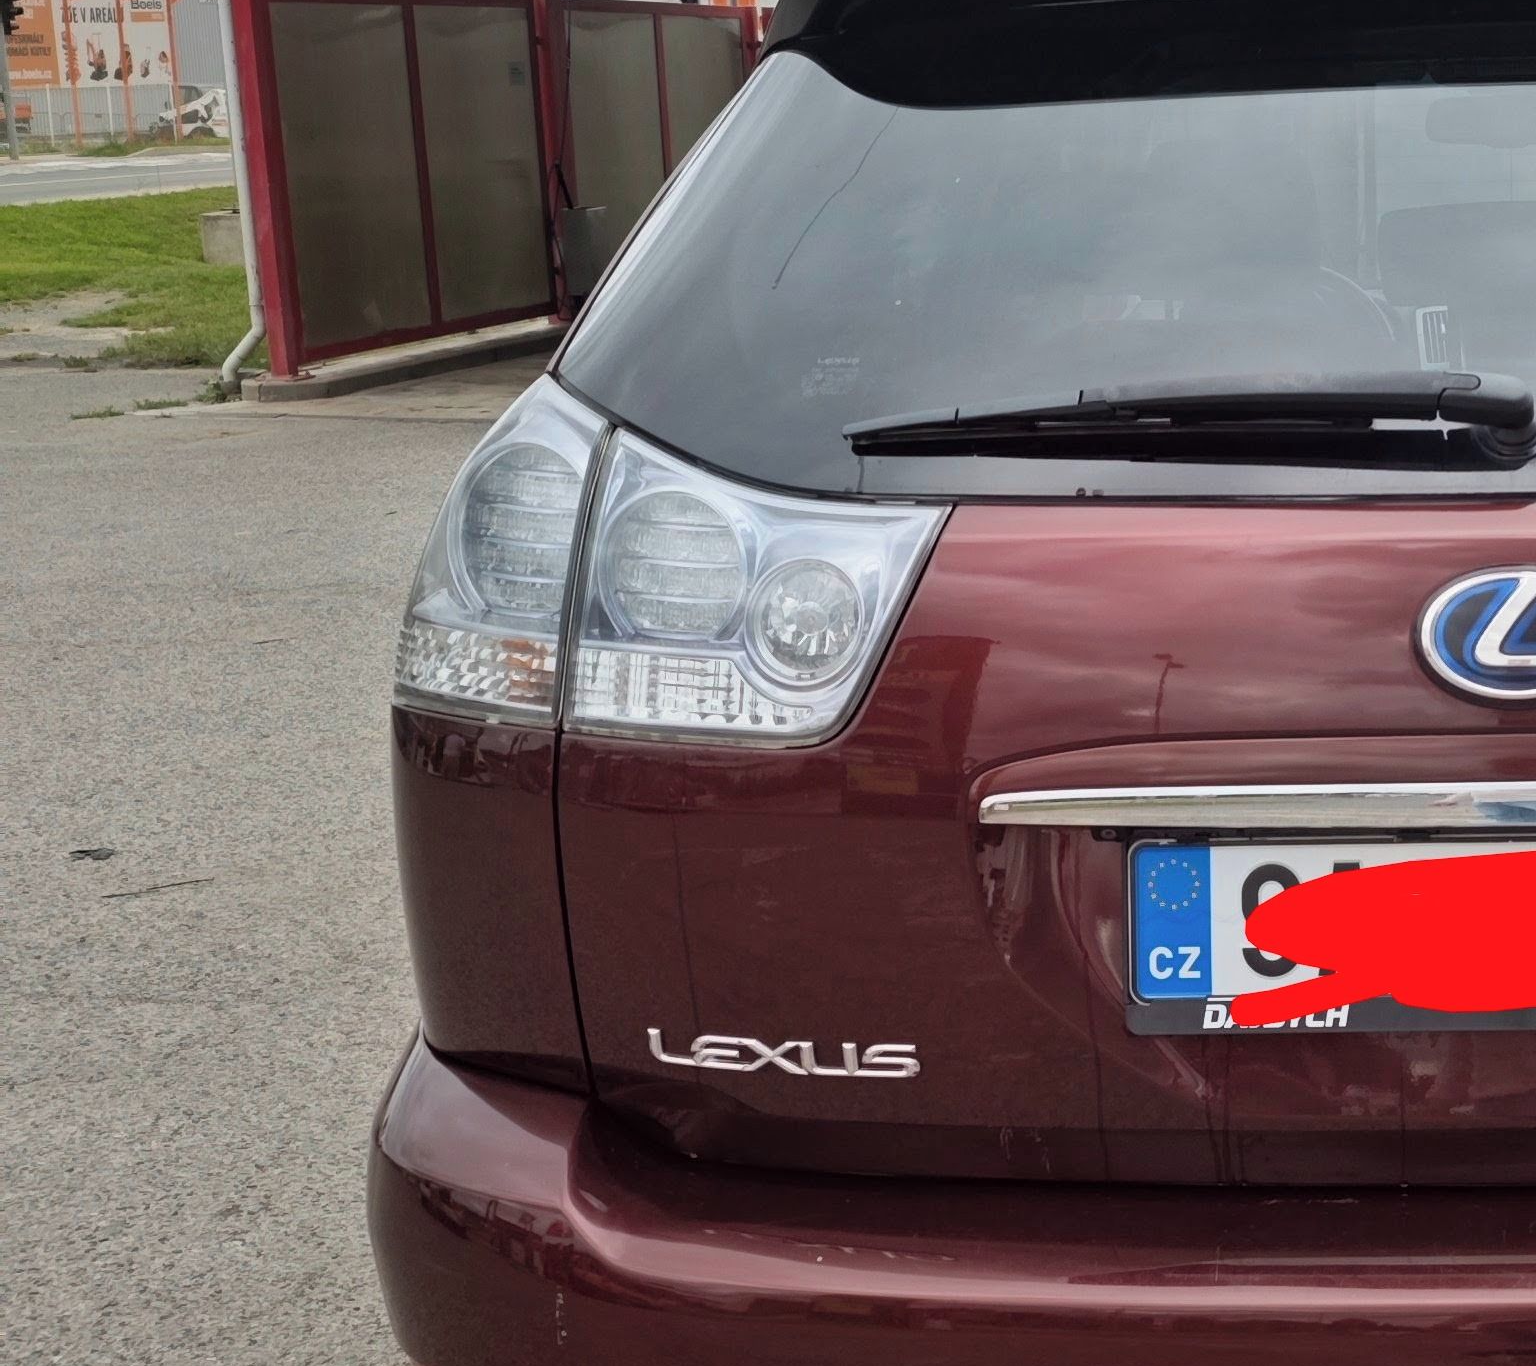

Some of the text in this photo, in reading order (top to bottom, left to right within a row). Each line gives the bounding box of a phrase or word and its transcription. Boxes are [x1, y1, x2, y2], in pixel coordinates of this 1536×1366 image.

[79, 7, 86, 23] V
[89, 2, 124, 23] AREÁL
[1149, 946, 1202, 979] CZ
[647, 1028, 921, 1078] LEXUS
